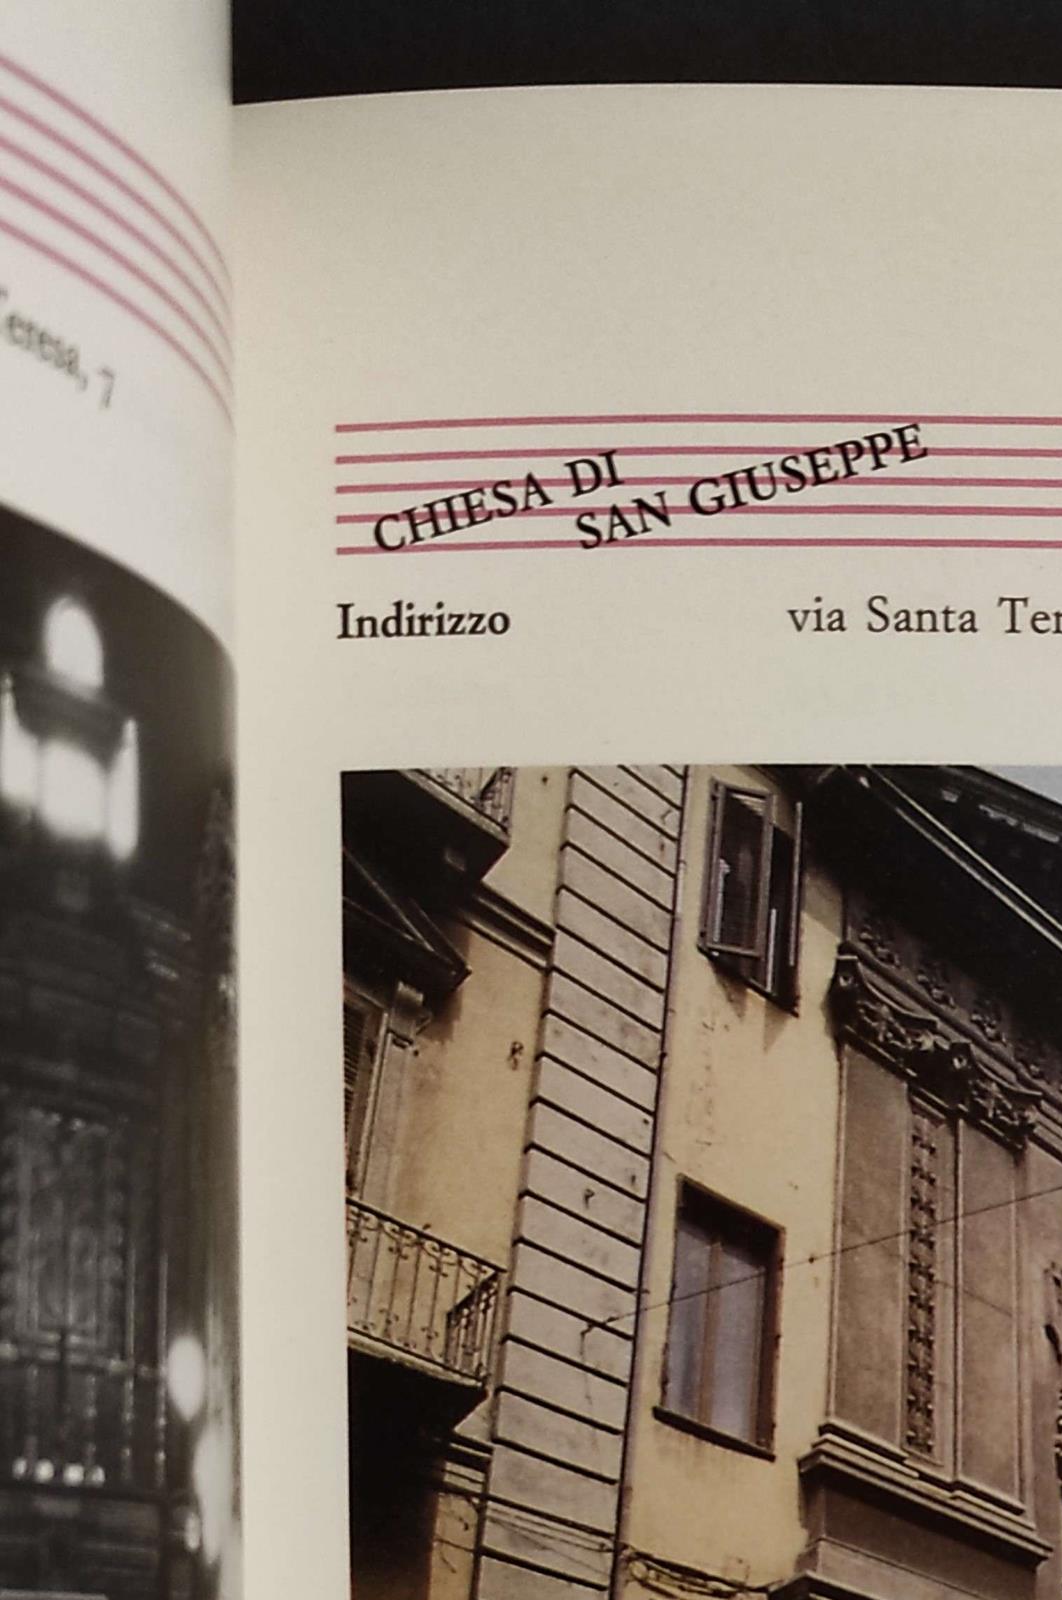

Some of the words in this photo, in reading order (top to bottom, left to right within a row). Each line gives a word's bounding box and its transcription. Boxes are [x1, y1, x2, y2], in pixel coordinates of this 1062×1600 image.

[0, 284, 88, 392] eresa,
[98, 366, 116, 408] 7
[373, 471, 554, 551] CHIESA
[563, 449, 625, 498] DI
[575, 491, 672, 550] SAN
[689, 423, 929, 526] GIUSEPPE
[336, 599, 511, 640] Indirizzo
[787, 596, 848, 633] via
[866, 595, 979, 634] Santa
